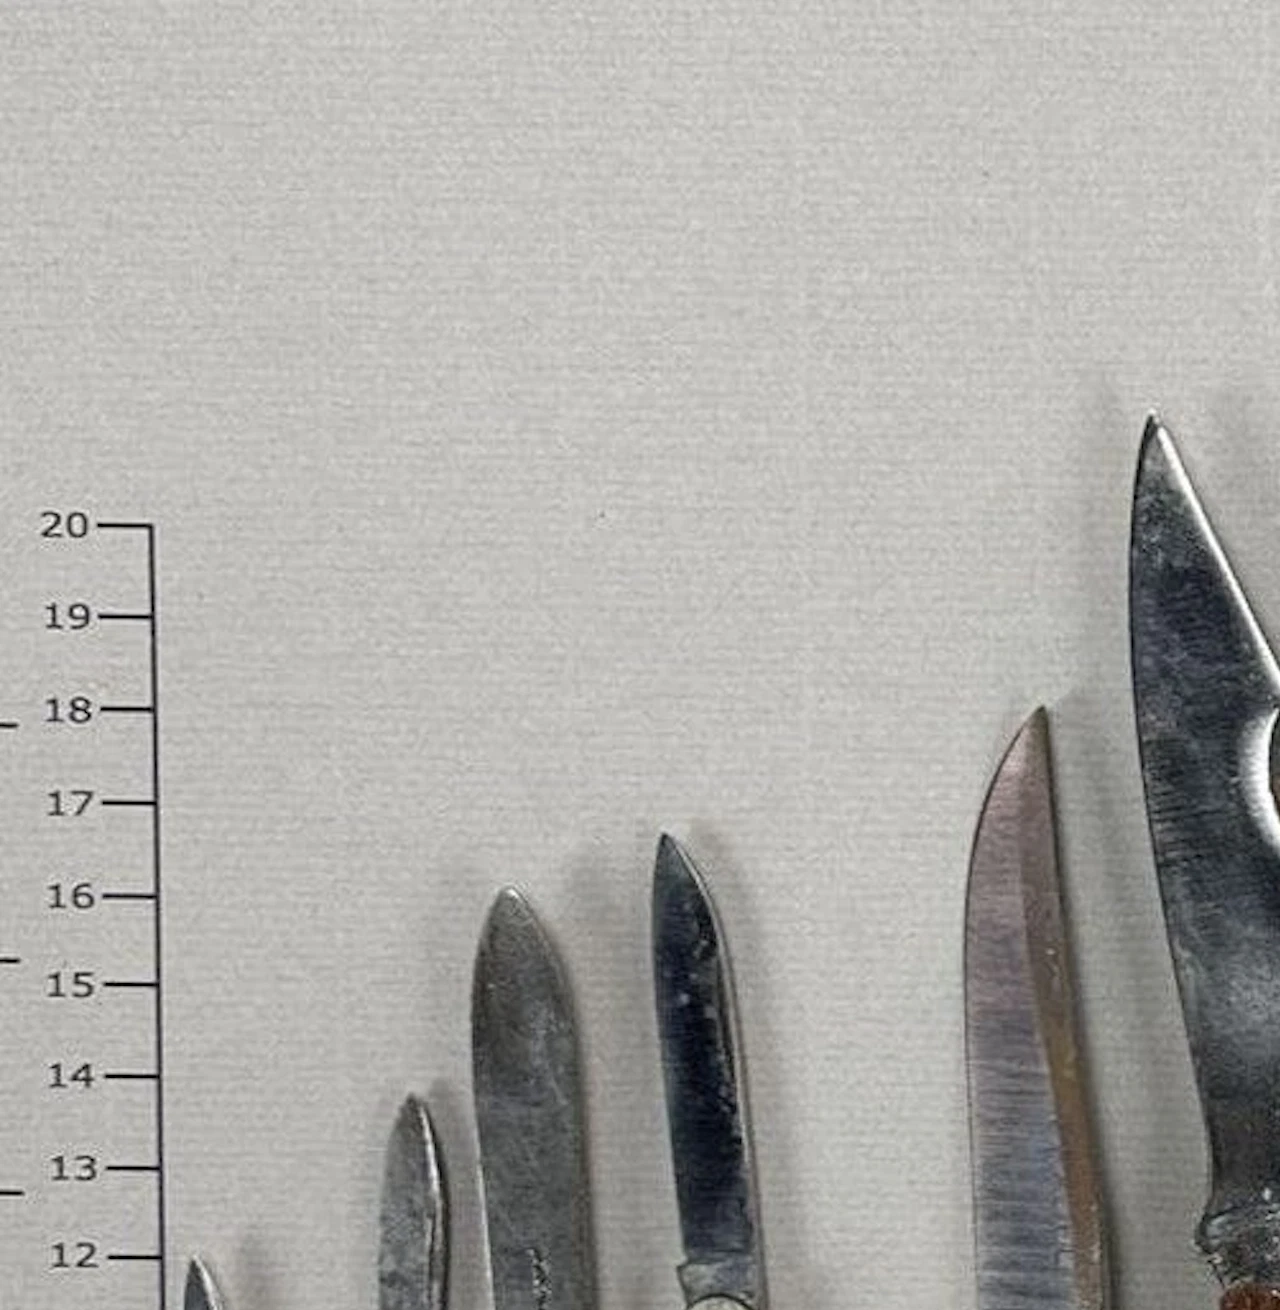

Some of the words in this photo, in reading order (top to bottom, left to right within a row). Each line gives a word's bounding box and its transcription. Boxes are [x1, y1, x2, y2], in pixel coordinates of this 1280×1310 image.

[41, 511, 89, 539] 20
[45, 602, 91, 630] 19
[46, 696, 92, 724] 18
[48, 790, 94, 817] 17
[48, 882, 95, 910] 16
[48, 971, 94, 998] 15
[49, 1063, 95, 1089] 14
[51, 1155, 97, 1182] 13
[52, 1242, 99, 1268] 12
